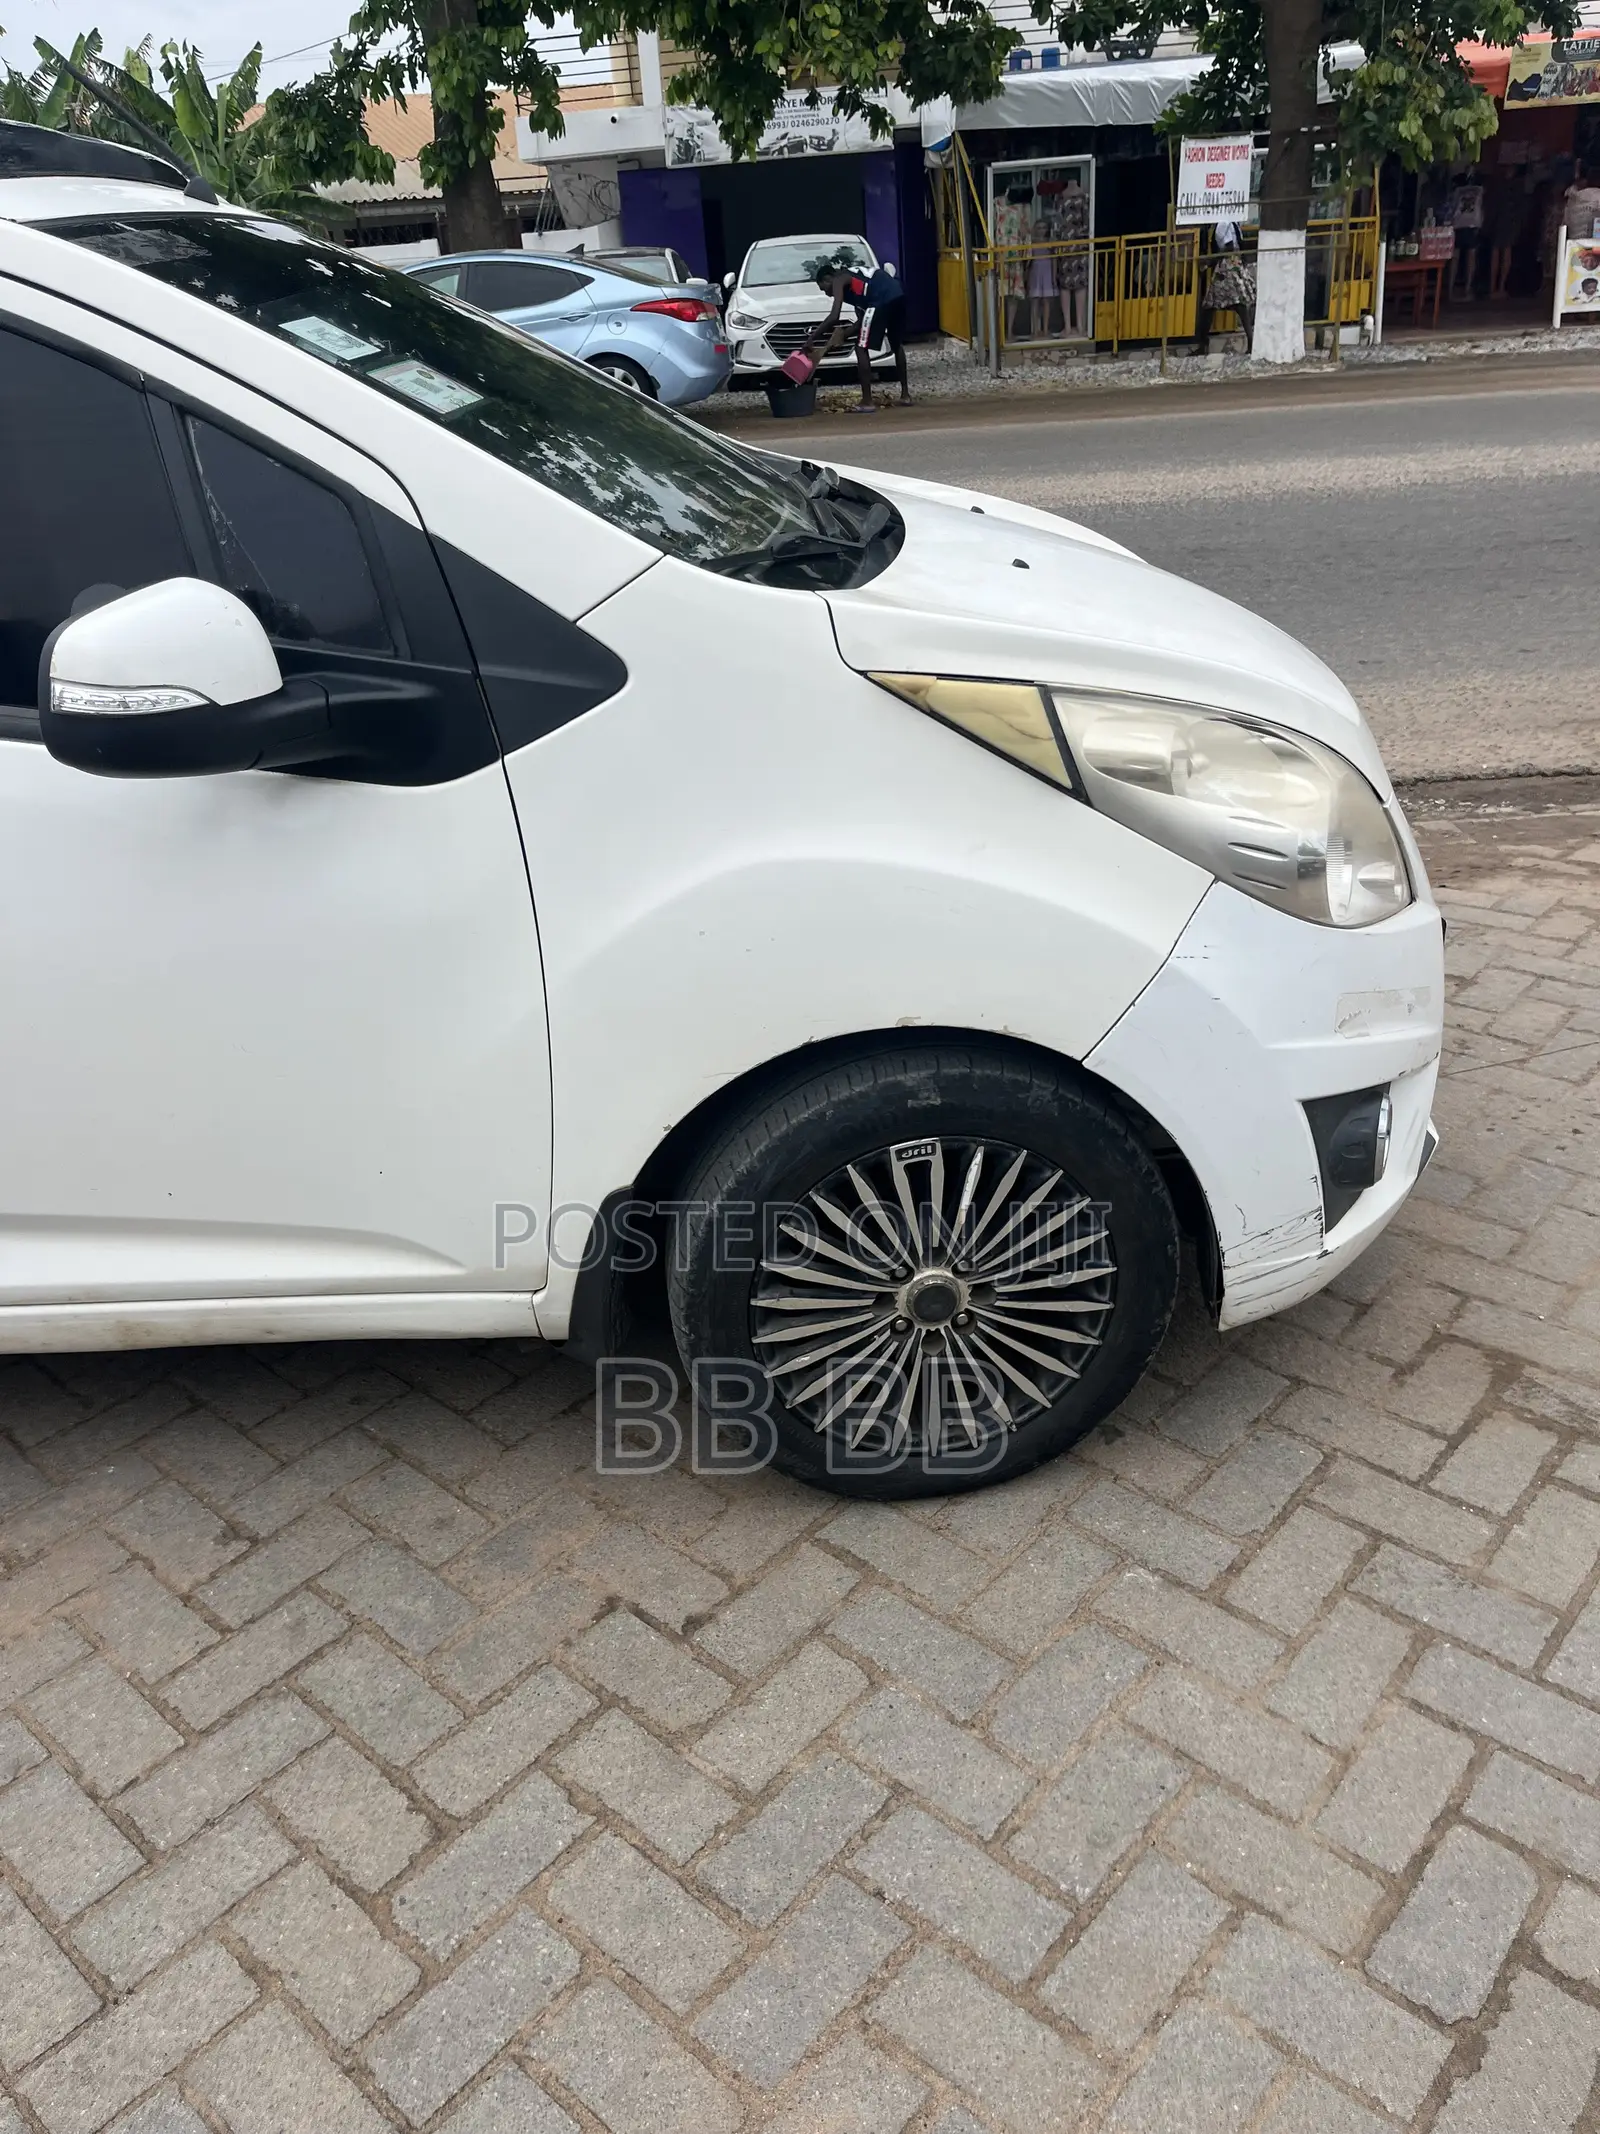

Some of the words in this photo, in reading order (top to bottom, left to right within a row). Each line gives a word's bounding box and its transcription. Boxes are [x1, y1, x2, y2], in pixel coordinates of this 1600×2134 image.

[774, 98, 798, 109] AKYE
[799, 95, 839, 108] MOR
[790, 117, 840, 128] 0246290270
[1206, 172, 1225, 188] NEEDED
